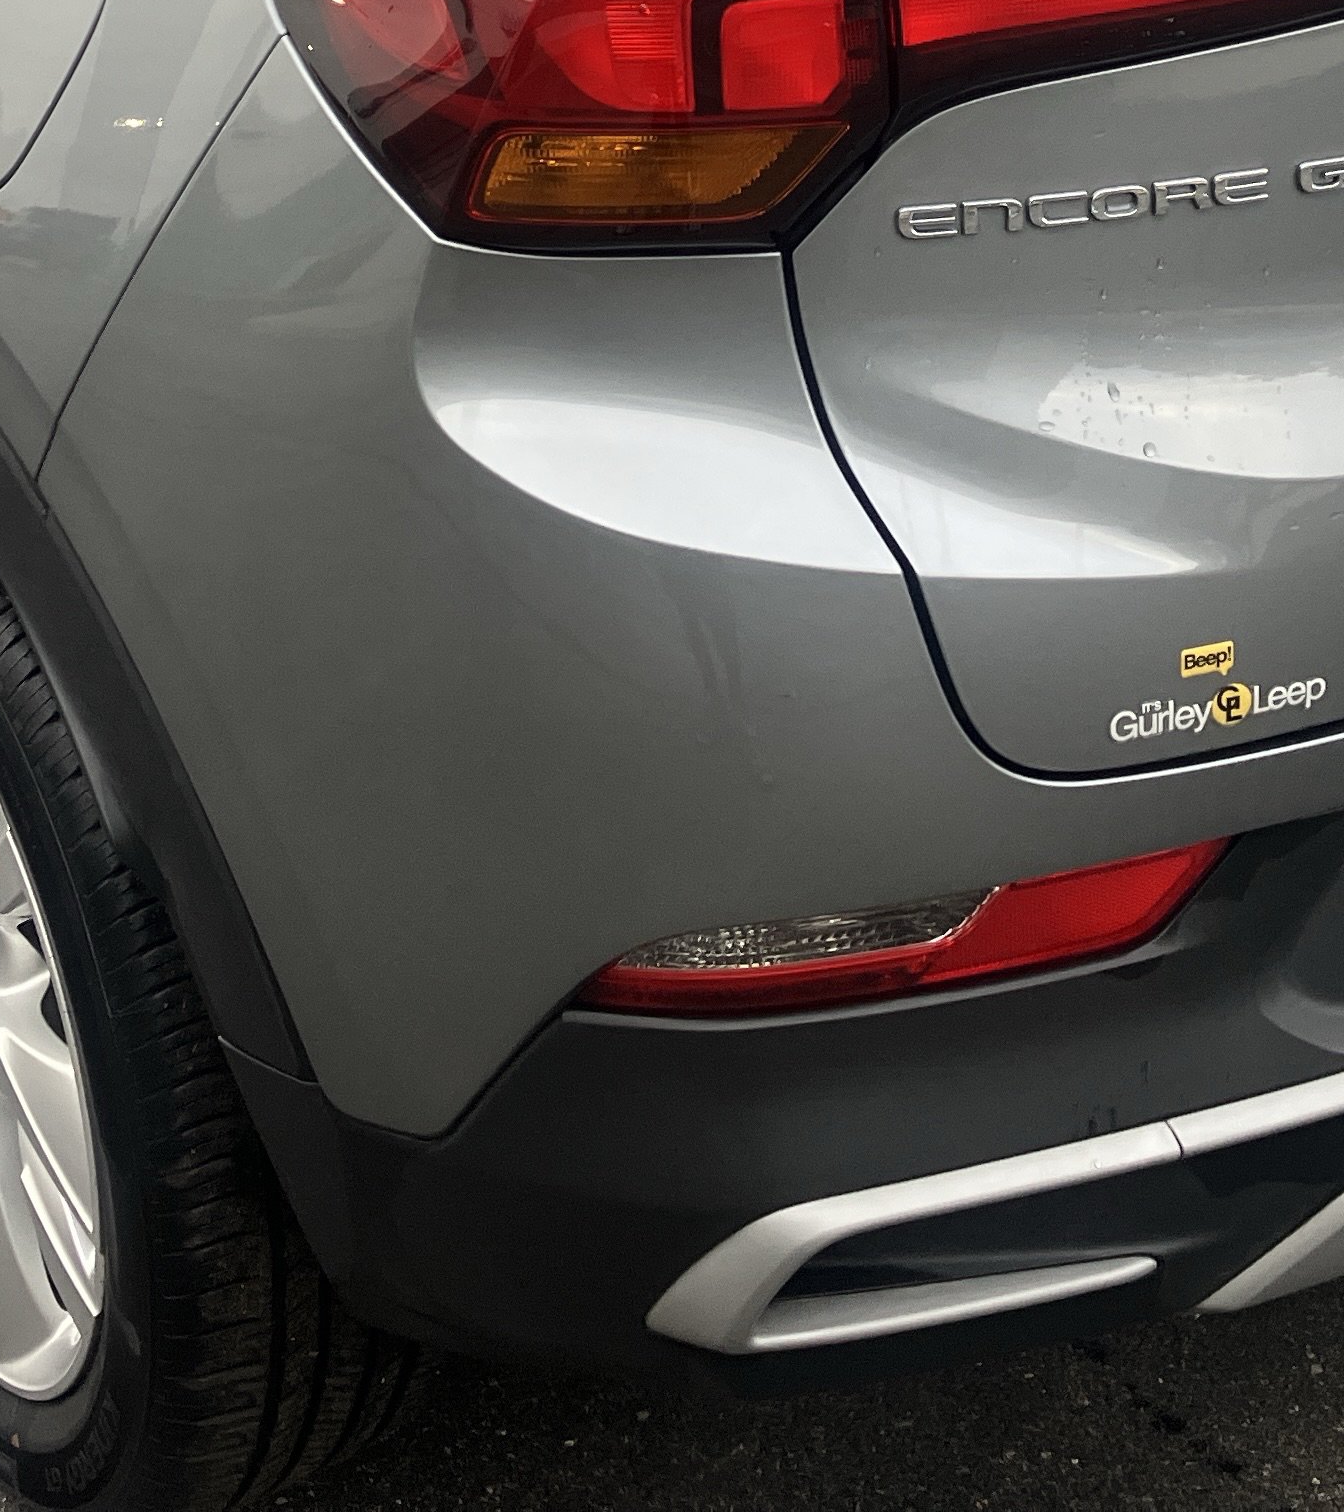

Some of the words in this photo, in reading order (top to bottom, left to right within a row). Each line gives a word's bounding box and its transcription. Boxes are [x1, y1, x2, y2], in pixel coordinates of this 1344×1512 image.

[897, 167, 1269, 240] ENCORE
[1183, 646, 1233, 671] Beep!
[1109, 699, 1214, 742] Gurley
[1252, 676, 1327, 715] Leep
